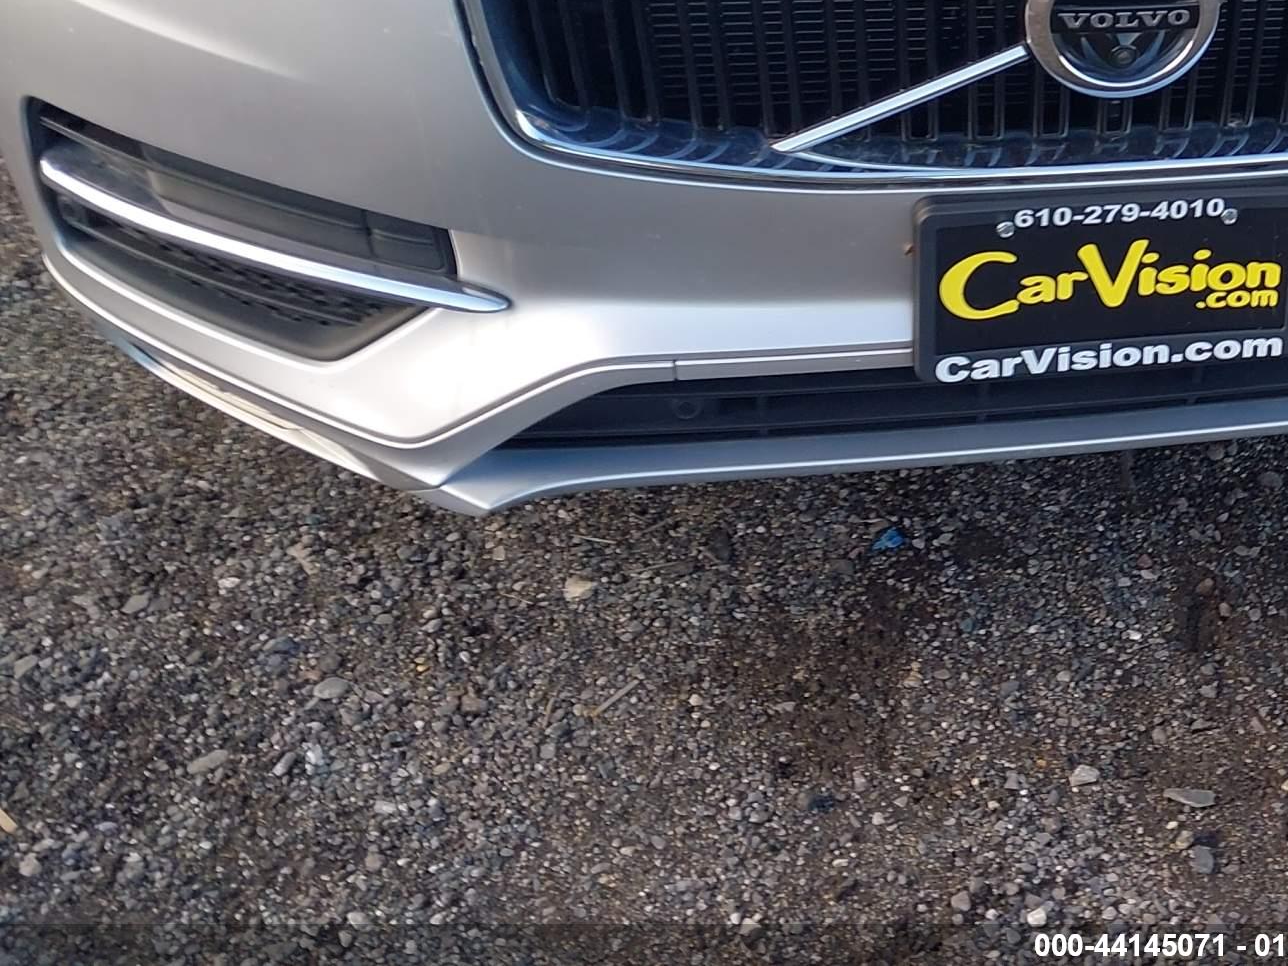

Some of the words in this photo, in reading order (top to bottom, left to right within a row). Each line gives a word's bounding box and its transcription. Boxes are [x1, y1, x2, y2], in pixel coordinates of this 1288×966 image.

[1057, 9, 1191, 30] VOLVO
[1014, 198, 1225, 229] 610-279-4010
[938, 239, 1281, 320] CarVision
[1195, 288, 1279, 309] .com
[934, 336, 1283, 384] CarVision.com
